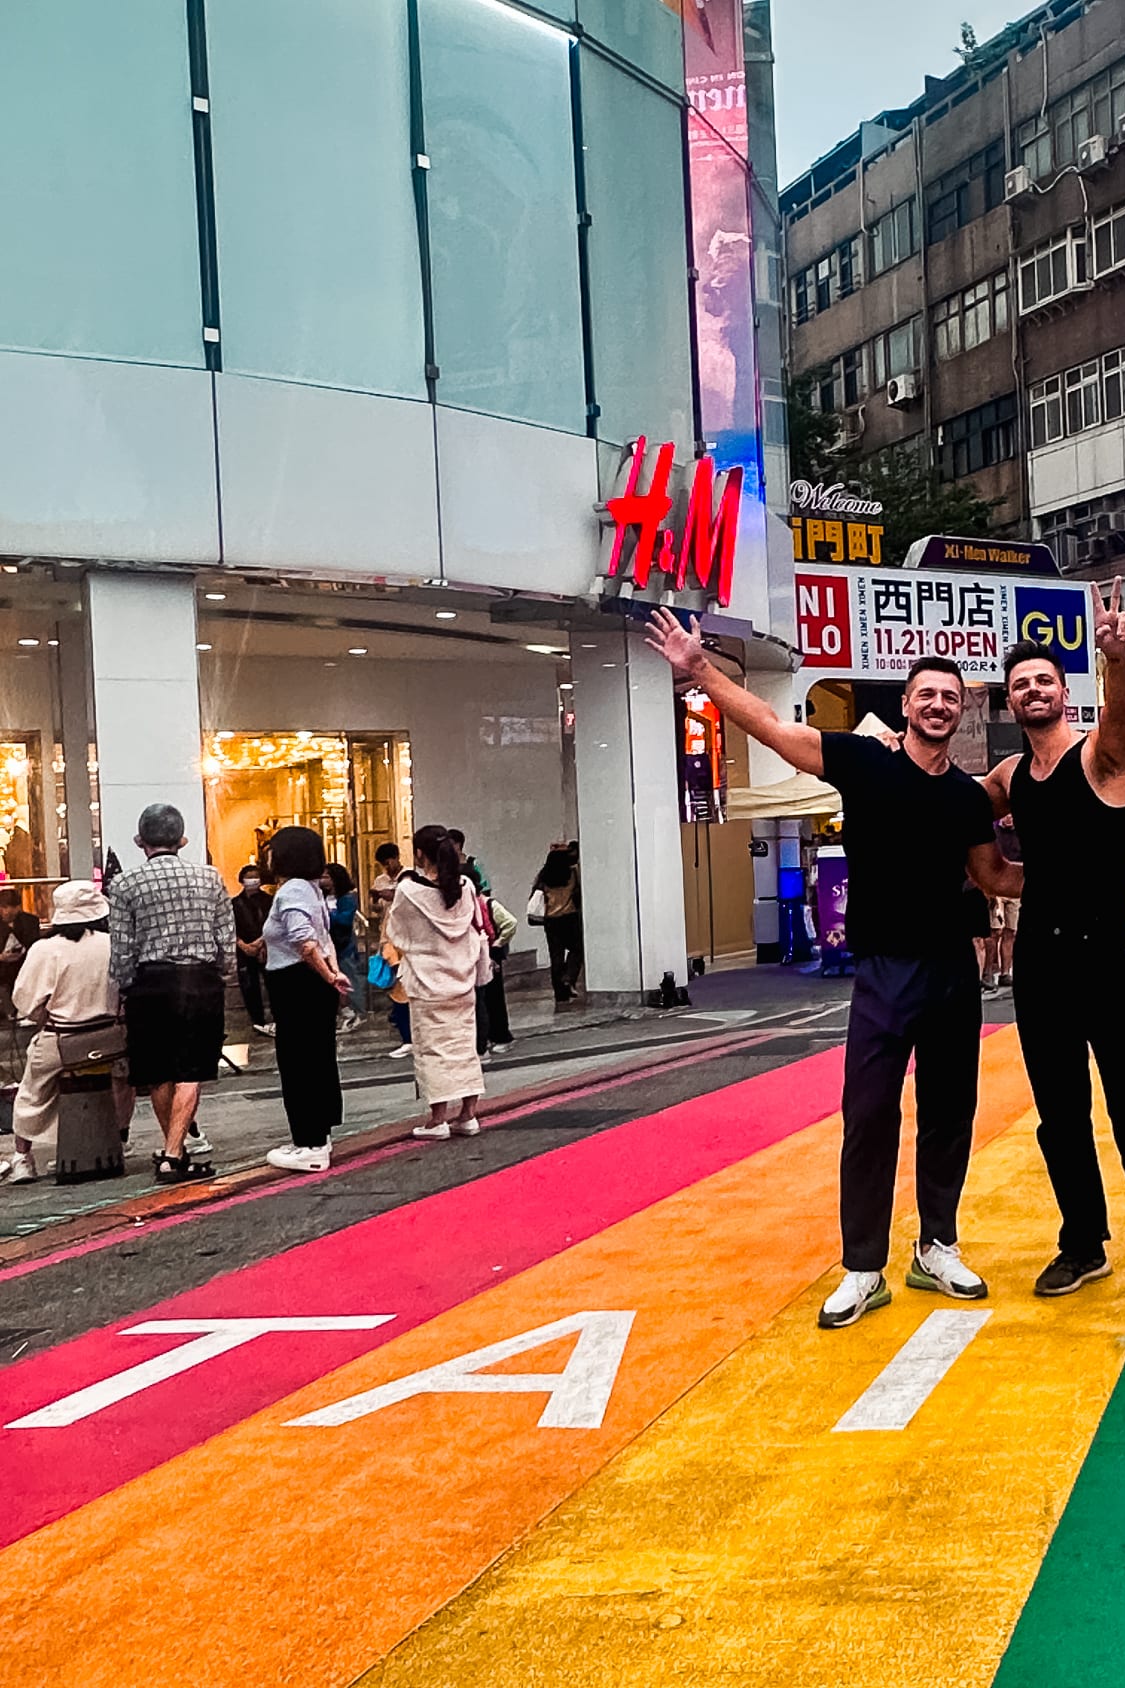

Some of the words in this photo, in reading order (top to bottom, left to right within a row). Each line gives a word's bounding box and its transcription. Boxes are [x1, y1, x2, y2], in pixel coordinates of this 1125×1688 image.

[790, 480, 883, 515] Welcome
[604, 435, 744, 608] H&M
[988, 548, 1031, 564] Walker
[871, 578, 995, 628] 西門店
[874, 628, 924, 655] 11.21
[935, 630, 998, 658] OPEN
[1021, 611, 1084, 652] GU
